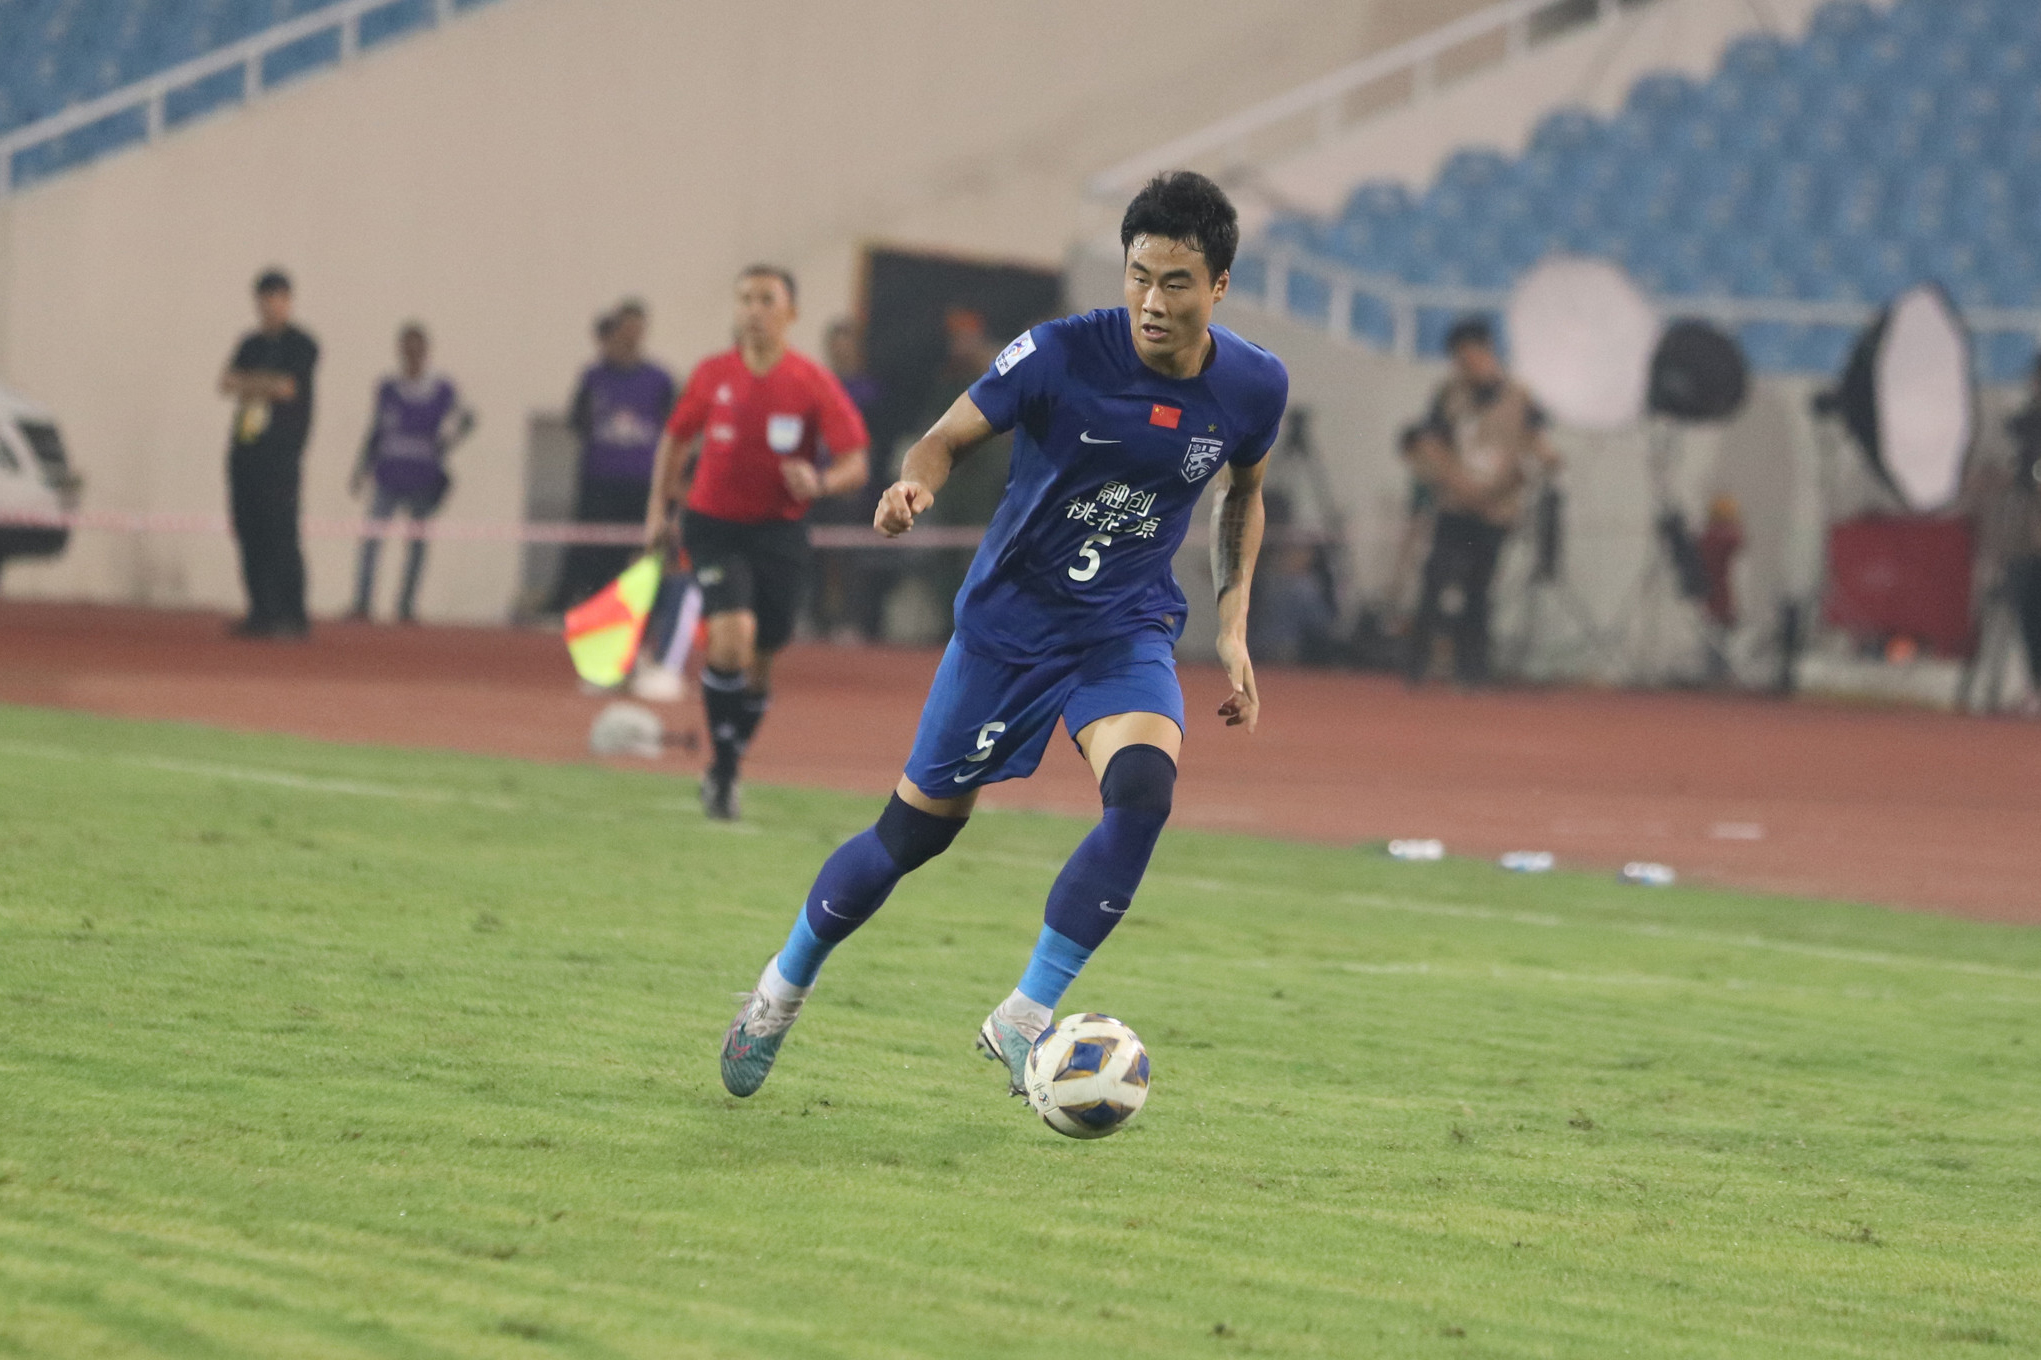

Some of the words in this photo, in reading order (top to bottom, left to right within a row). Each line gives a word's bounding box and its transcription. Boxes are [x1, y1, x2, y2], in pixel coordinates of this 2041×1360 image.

[1065, 497, 1161, 539] 桃花源
[1096, 481, 1157, 517] 融创
[1068, 533, 1112, 582] 5
[965, 721, 1006, 762] 5
